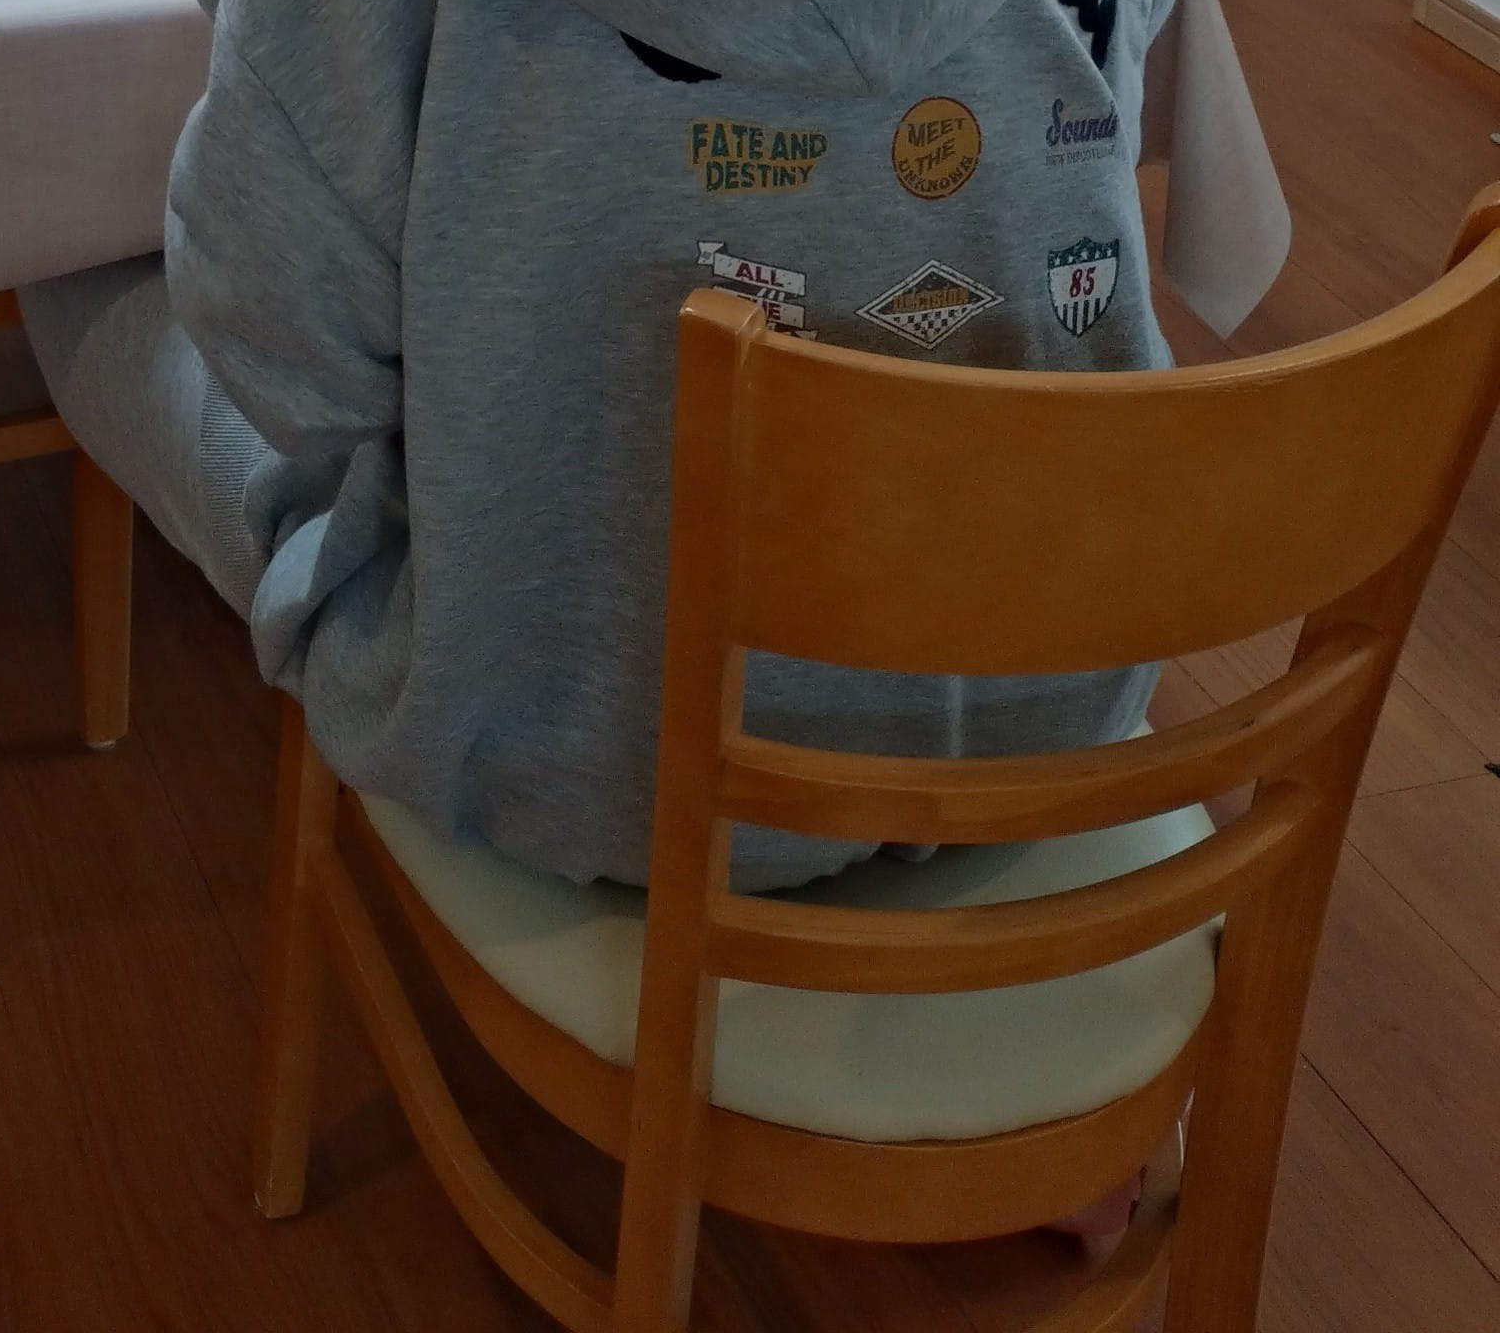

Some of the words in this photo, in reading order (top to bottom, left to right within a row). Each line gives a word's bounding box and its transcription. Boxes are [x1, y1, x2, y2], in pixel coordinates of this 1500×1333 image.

[692, 123, 764, 164] FATE
[771, 131, 828, 160] AND
[908, 118, 968, 147] MEET
[914, 137, 957, 174] THE
[706, 161, 814, 192] DESTINY
[898, 155, 977, 193] UNKNOWN
[735, 262, 785, 288] ALL
[1069, 266, 1097, 298] 85
